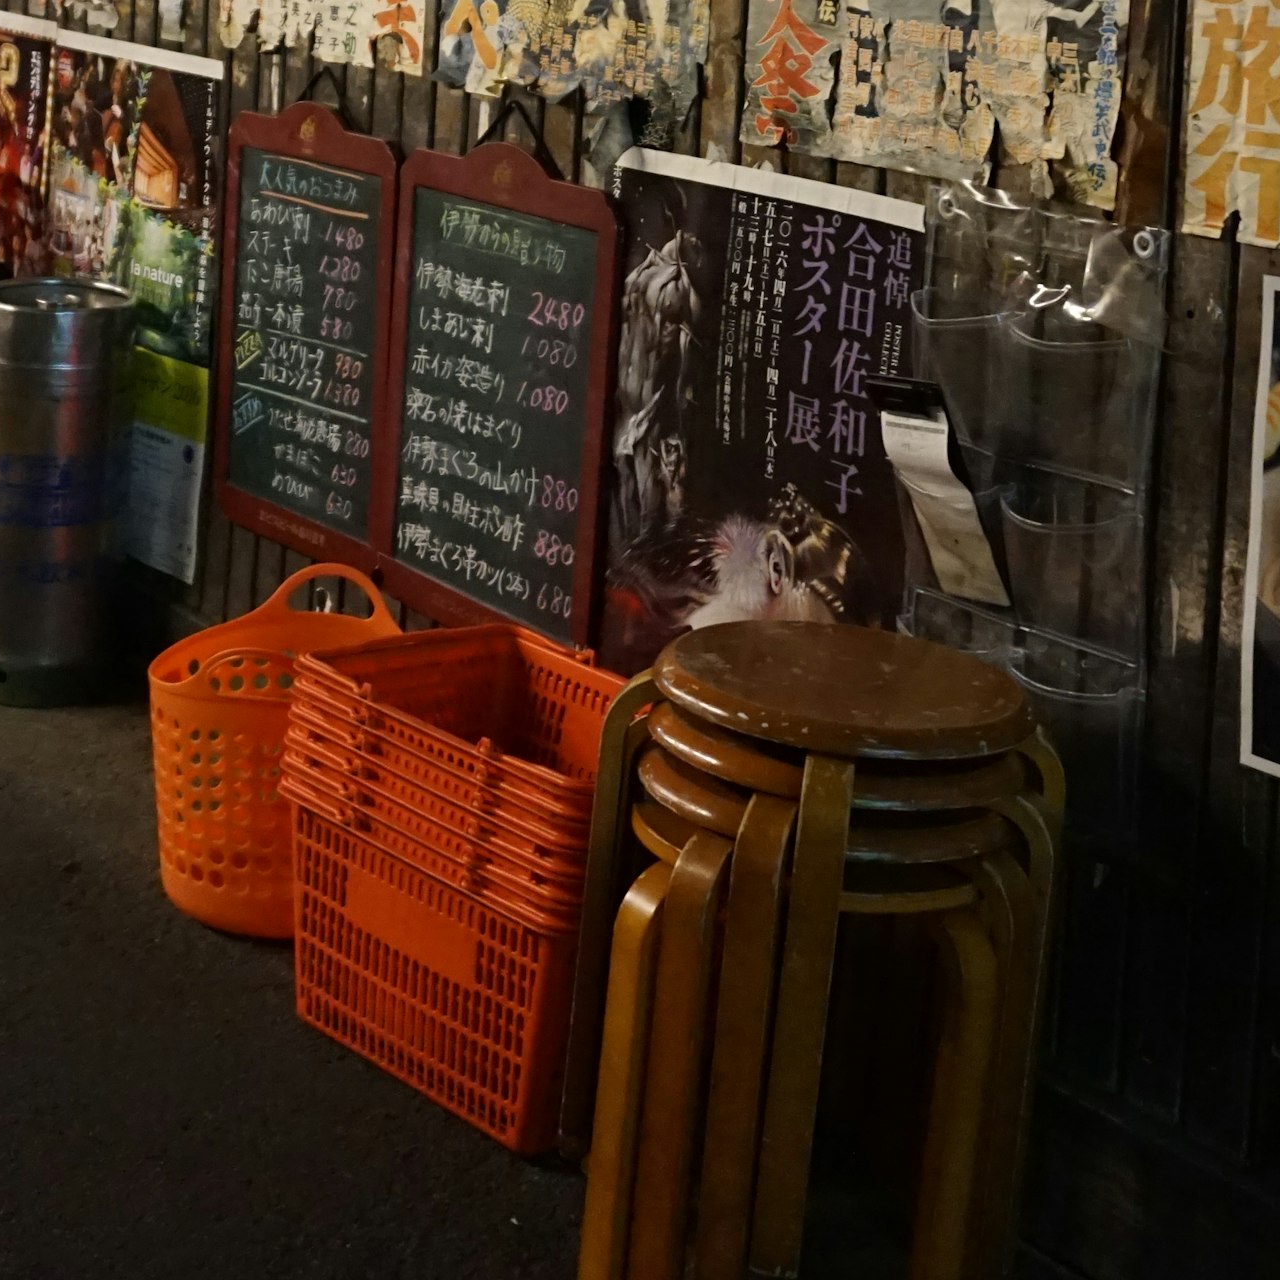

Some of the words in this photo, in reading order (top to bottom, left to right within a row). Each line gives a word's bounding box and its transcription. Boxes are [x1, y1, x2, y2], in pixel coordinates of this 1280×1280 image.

[260, 161, 359, 207] 大人気のおつまみ
[246, 230, 293, 264] ステーキ
[130, 258, 141, 277] la
[143, 262, 184, 289] nature
[882, 229, 913, 312] 追悼
[528, 291, 585, 331] 2480
[267, 336, 325, 371] マルゲリータ
[782, 213, 843, 455] ポスター展
[259, 361, 323, 400] ゴルゴンゾーラ
[823, 220, 884, 517] 合田佐和子
[541, 474, 579, 513] 880
[533, 528, 576, 566] 880
[536, 582, 573, 619] 680
